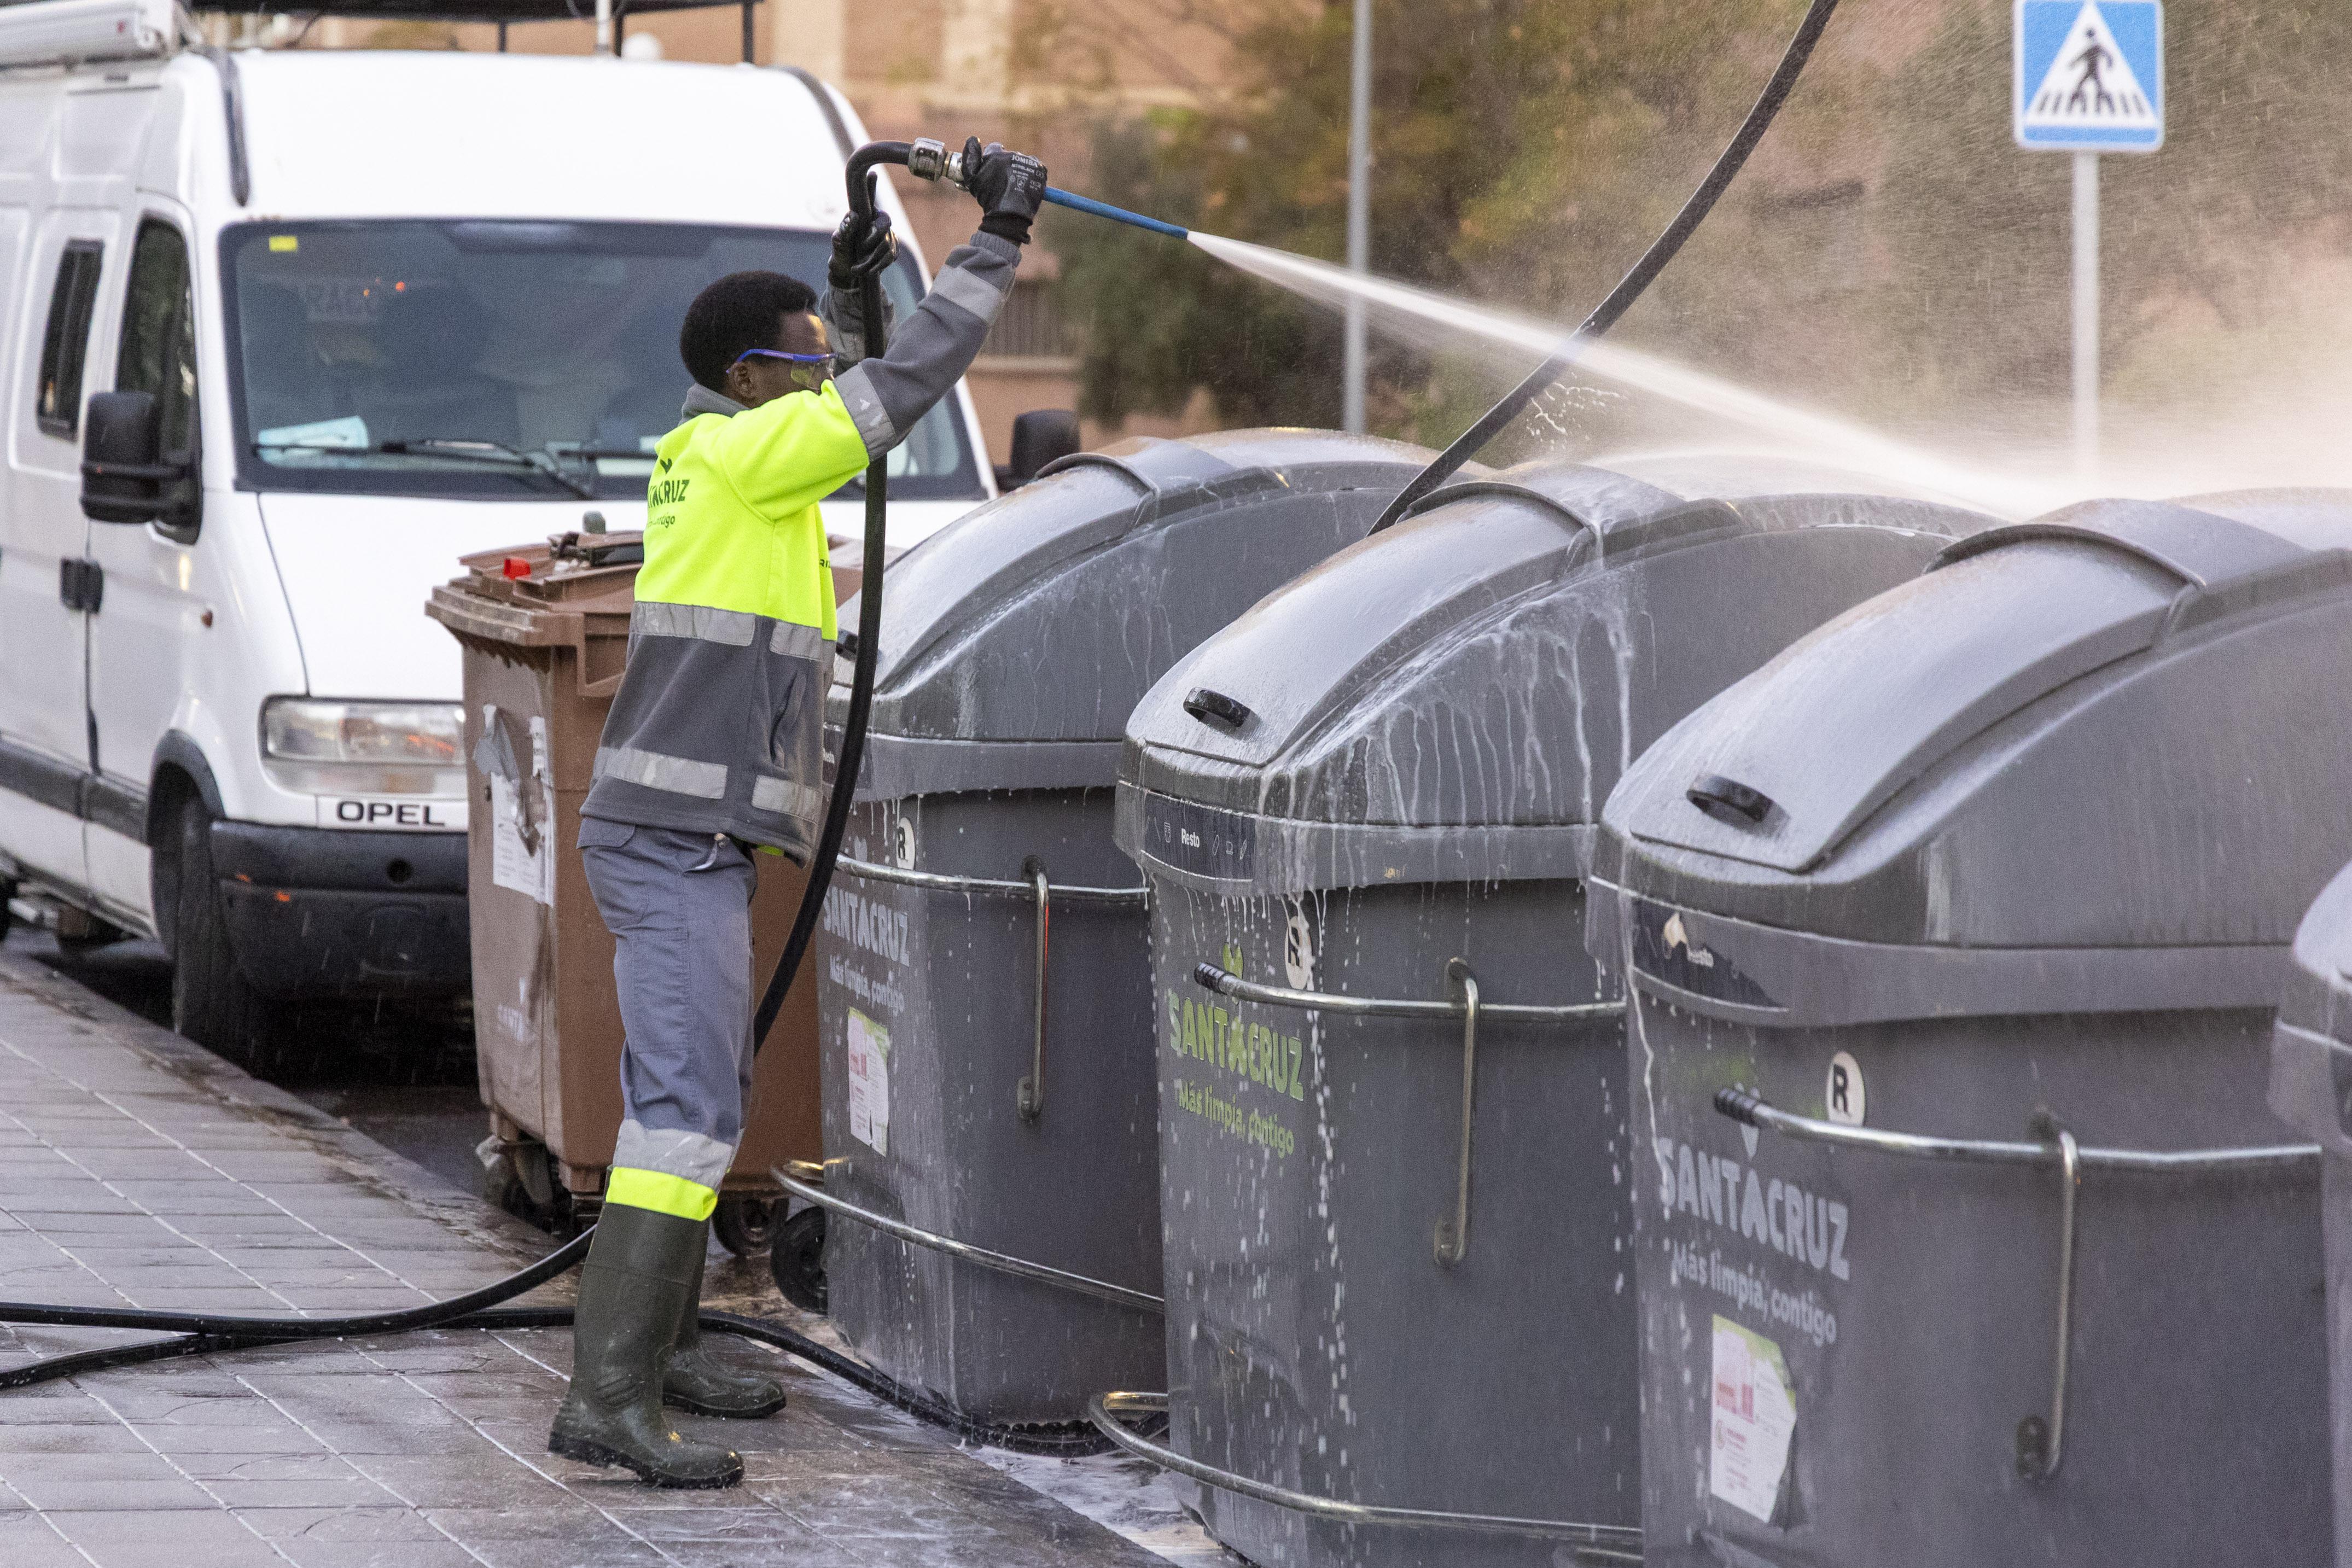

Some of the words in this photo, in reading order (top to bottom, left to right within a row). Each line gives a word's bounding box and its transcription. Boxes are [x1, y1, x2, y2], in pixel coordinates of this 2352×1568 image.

[1011, 154, 1038, 167] JOMIBA
[336, 800, 445, 827] OPEL
[1180, 827, 1201, 848] Resto
[898, 826, 907, 861] R
[1168, 991, 1304, 1101] SANTACRUZ
[1832, 1063, 1850, 1115] R
[1179, 1080, 1202, 1115] Más
[1204, 1085, 1246, 1139] limpia,
[1248, 1111, 1295, 1159] contigo
[1657, 1136, 1849, 1281] SANTACRUZ
[1672, 1239, 1707, 1286] Más
[1710, 1249, 1768, 1320] limpia,
[1771, 1290, 1837, 1348] contigo
